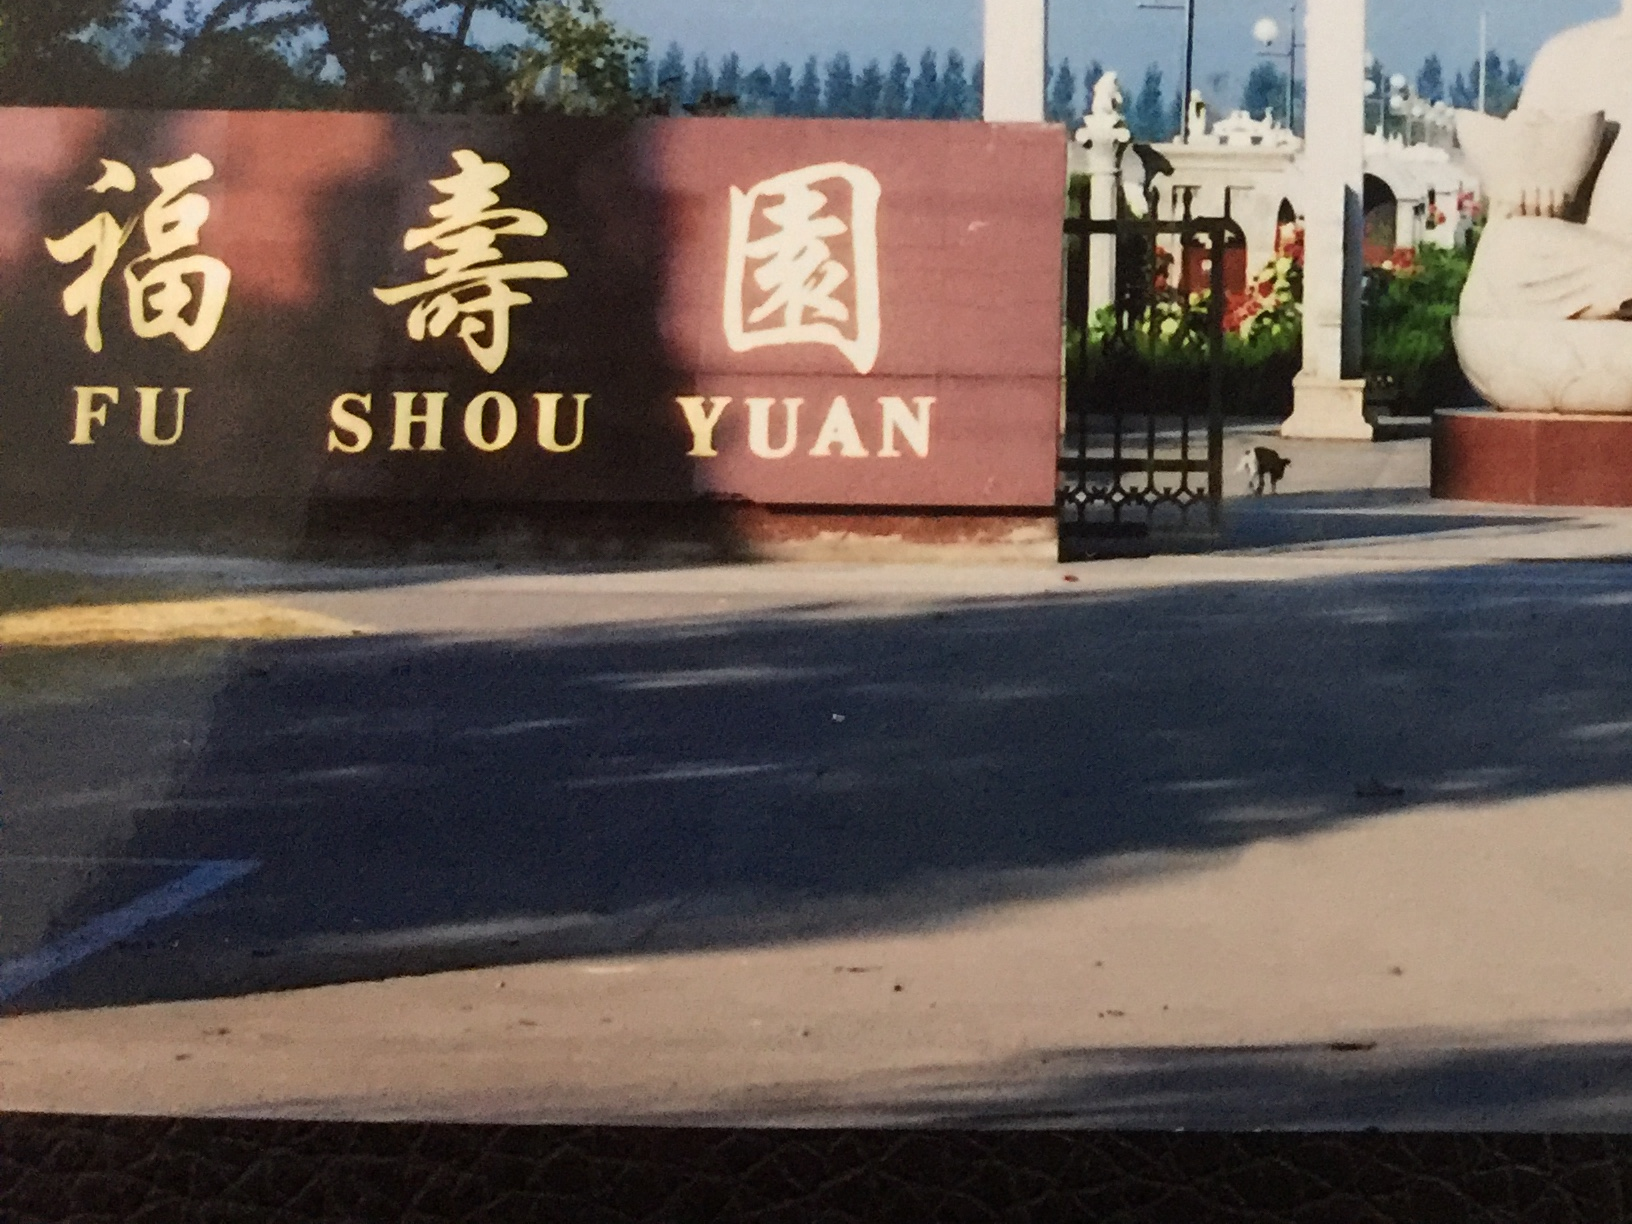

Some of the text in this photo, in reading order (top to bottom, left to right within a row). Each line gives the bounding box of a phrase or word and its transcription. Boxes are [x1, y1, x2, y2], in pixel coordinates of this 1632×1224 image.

[44, 149, 883, 375] 福壽園
[69, 386, 937, 460] FU SHOU YUAN
